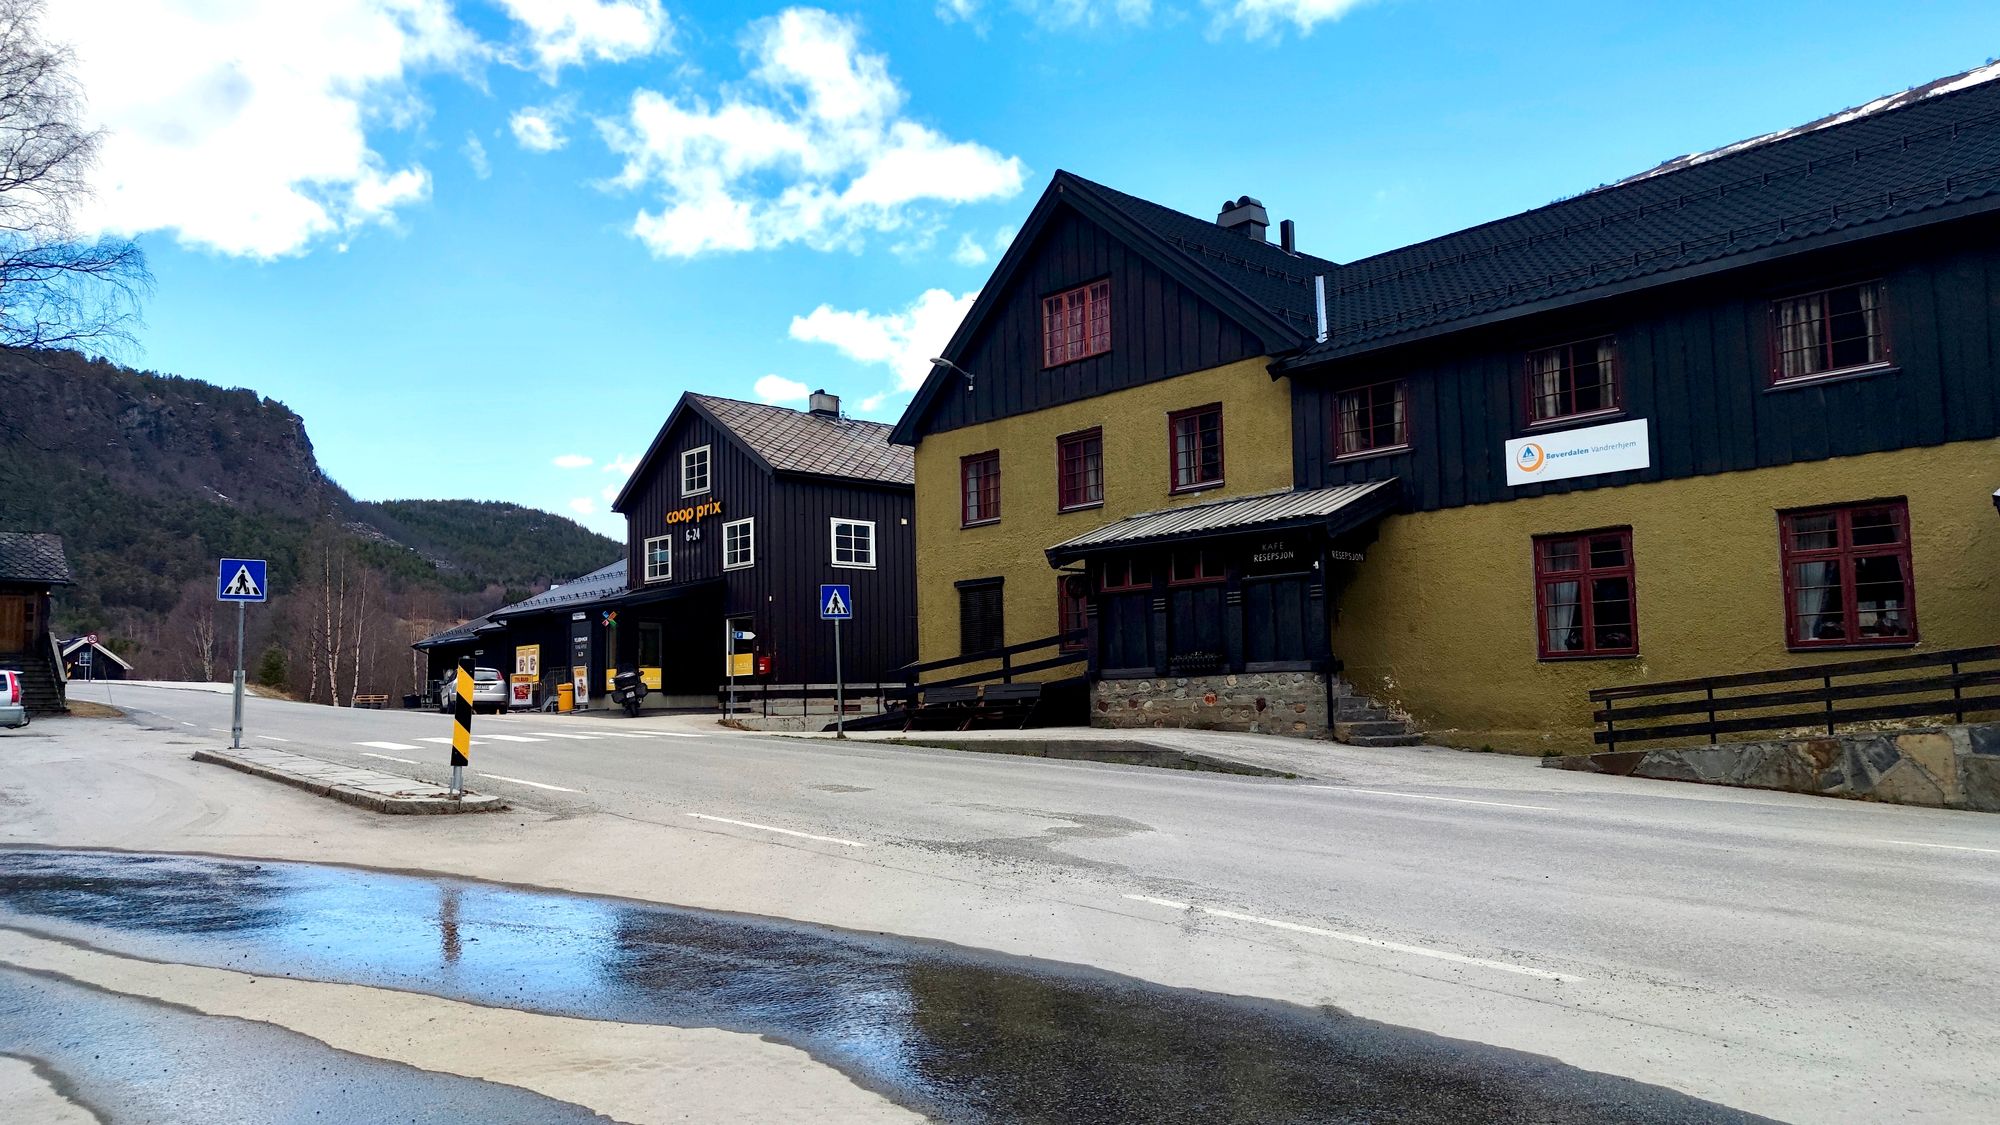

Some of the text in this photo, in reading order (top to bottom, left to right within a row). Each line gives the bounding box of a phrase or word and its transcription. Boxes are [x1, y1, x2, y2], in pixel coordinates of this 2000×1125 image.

[1546, 441, 1637, 460] Bøverdalen Vandrerhjem
[666, 496, 722, 524] coop prix
[685, 527, 700, 541] 6-24
[1262, 541, 1284, 551] KAFE
[1253, 551, 1294, 562] RESEPSJON
[1331, 550, 1364, 561] RESEPSJON
